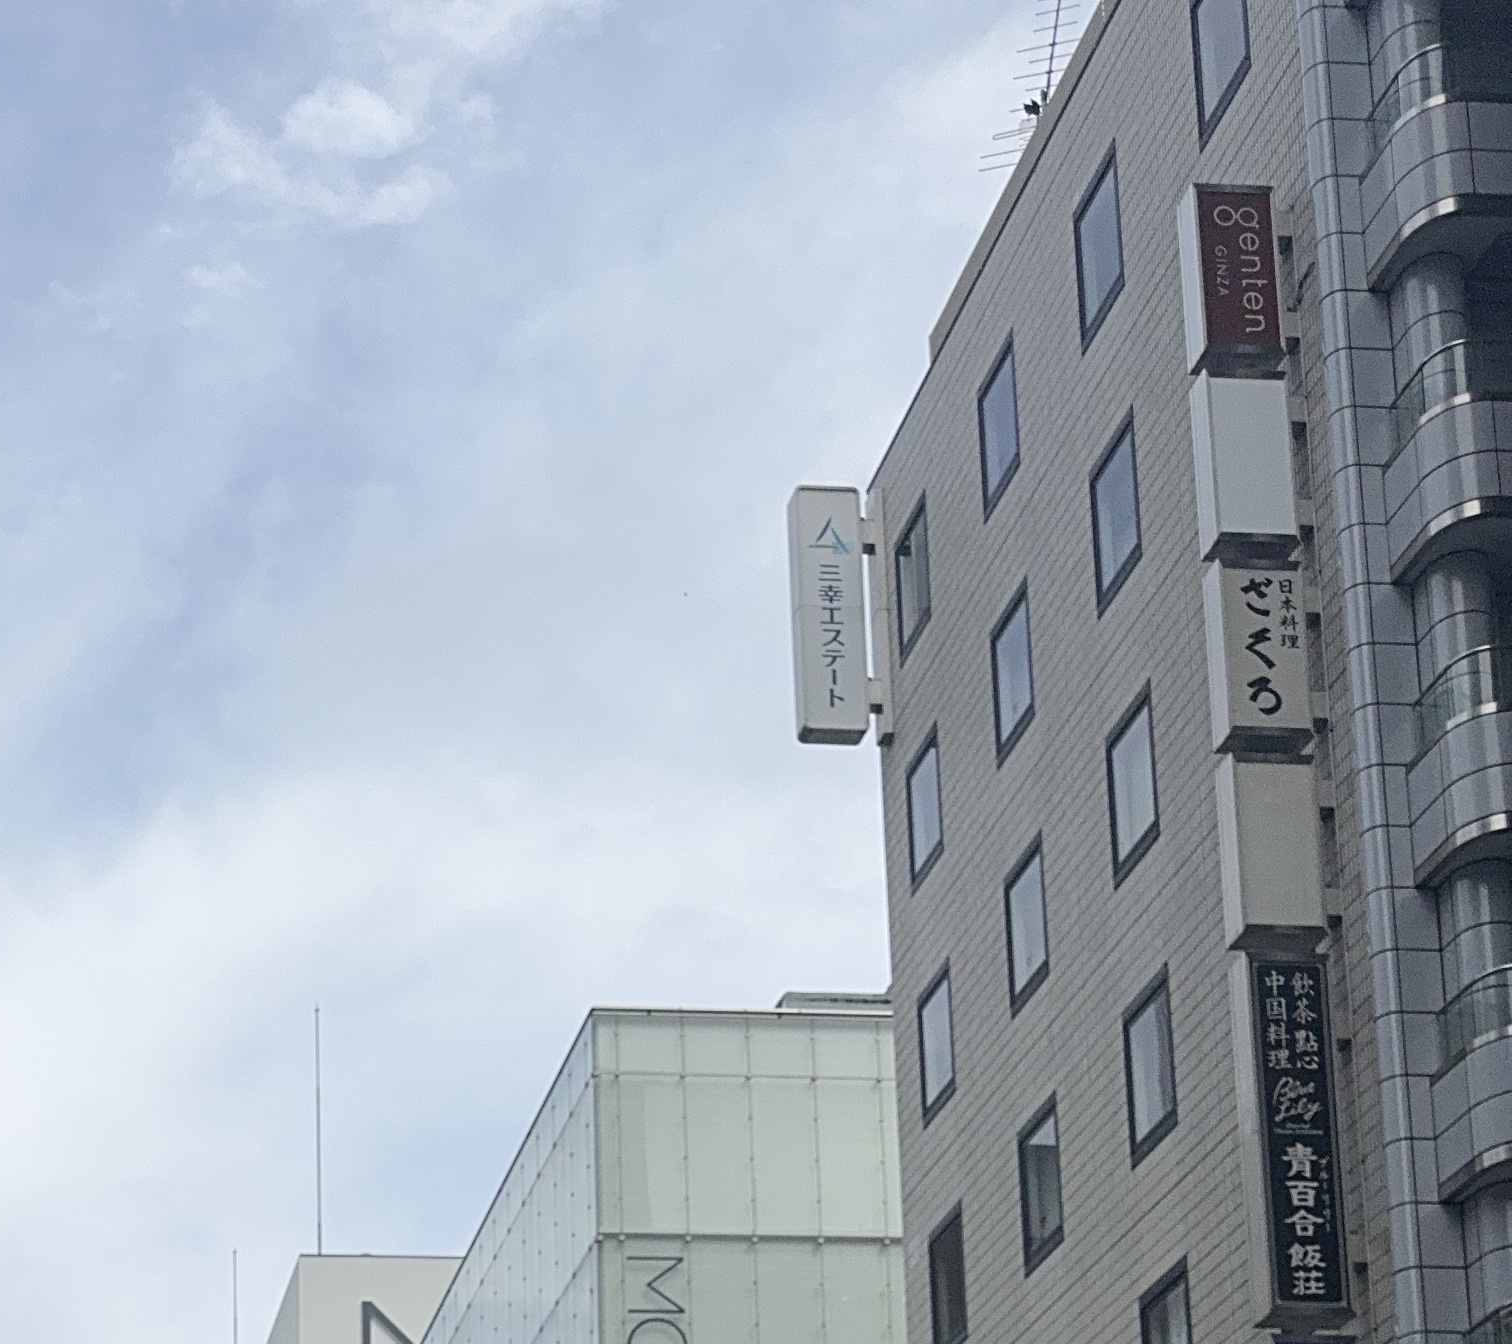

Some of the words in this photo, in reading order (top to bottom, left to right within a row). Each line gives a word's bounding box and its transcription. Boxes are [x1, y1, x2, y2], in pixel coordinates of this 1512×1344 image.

[1213, 205, 1268, 333] genten
[1214, 244, 1229, 296] GINZA
[816, 563, 847, 709] 三幸エステート
[1240, 577, 1283, 716] ざくろ
[1278, 578, 1300, 649] 日本料理
[1264, 970, 1292, 1070] 中国料理
[1281, 1142, 1326, 1297] 青百合飯荘
